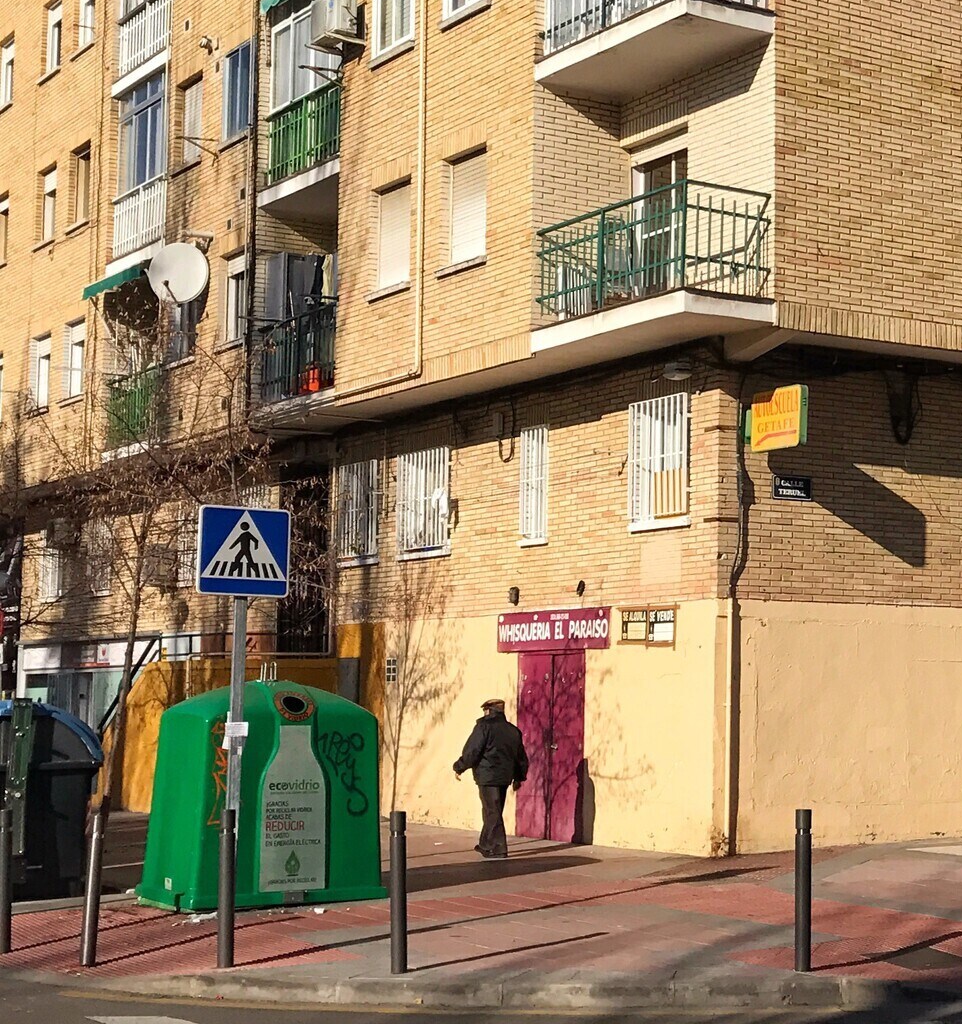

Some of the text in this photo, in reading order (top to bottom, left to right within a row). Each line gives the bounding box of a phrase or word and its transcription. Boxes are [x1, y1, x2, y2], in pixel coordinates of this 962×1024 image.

[757, 418, 793, 433] GETAFE
[623, 611, 629, 622] SE
[656, 609, 674, 622] VENDE
[554, 621, 564, 640] EL
[568, 618, 608, 639] PARAISO
[268, 778, 320, 791] ecovidrio
[265, 820, 305, 832] REDUCIR
